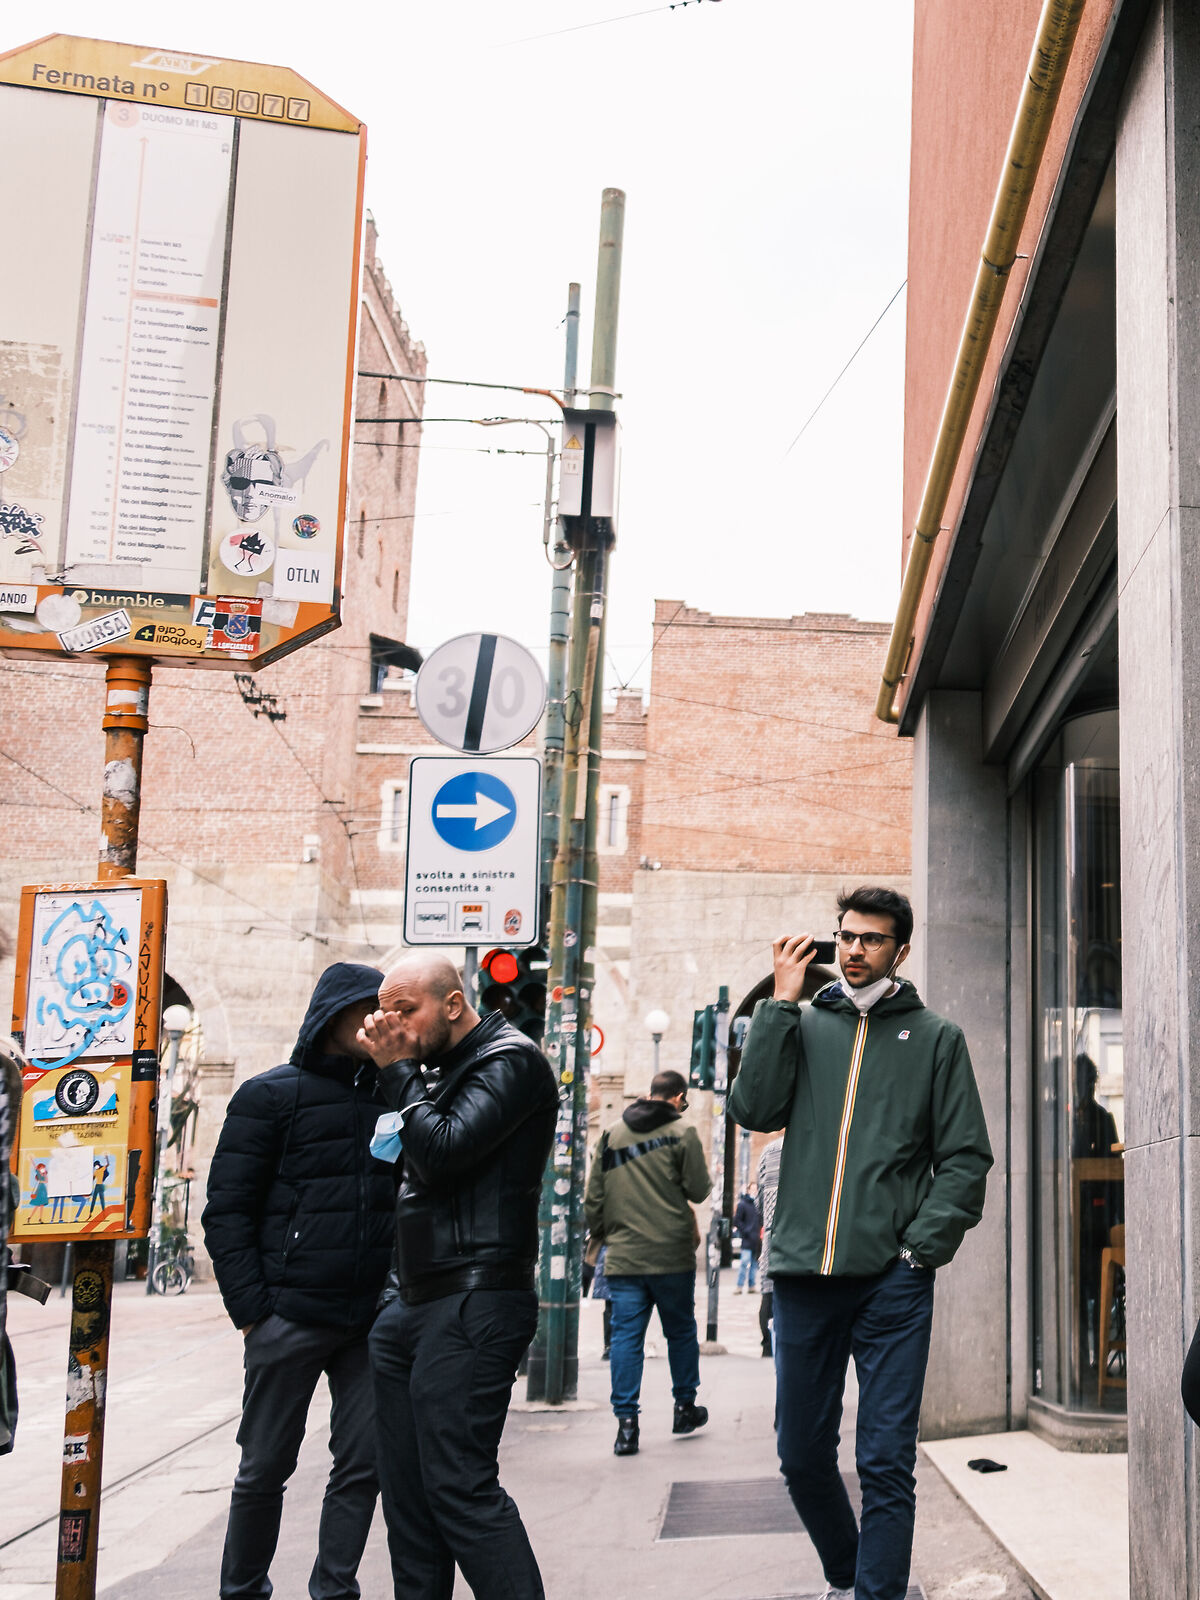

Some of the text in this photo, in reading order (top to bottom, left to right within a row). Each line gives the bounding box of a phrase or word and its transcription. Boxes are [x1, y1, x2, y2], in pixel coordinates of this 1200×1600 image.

[159, 55, 192, 71] ATM
[32, 63, 309, 120] Fermata n° 15077
[119, 108, 218, 131] 3 DUOMO M1 M3
[258, 490, 297, 502] Anomalo!
[287, 567, 320, 584] OTLN
[91, 591, 165, 608] bumble
[155, 634, 203, 649] Football
[436, 665, 526, 719] 30
[415, 870, 454, 880] svolta
[472, 870, 515, 879] sinistra
[415, 884, 479, 893] consentita
